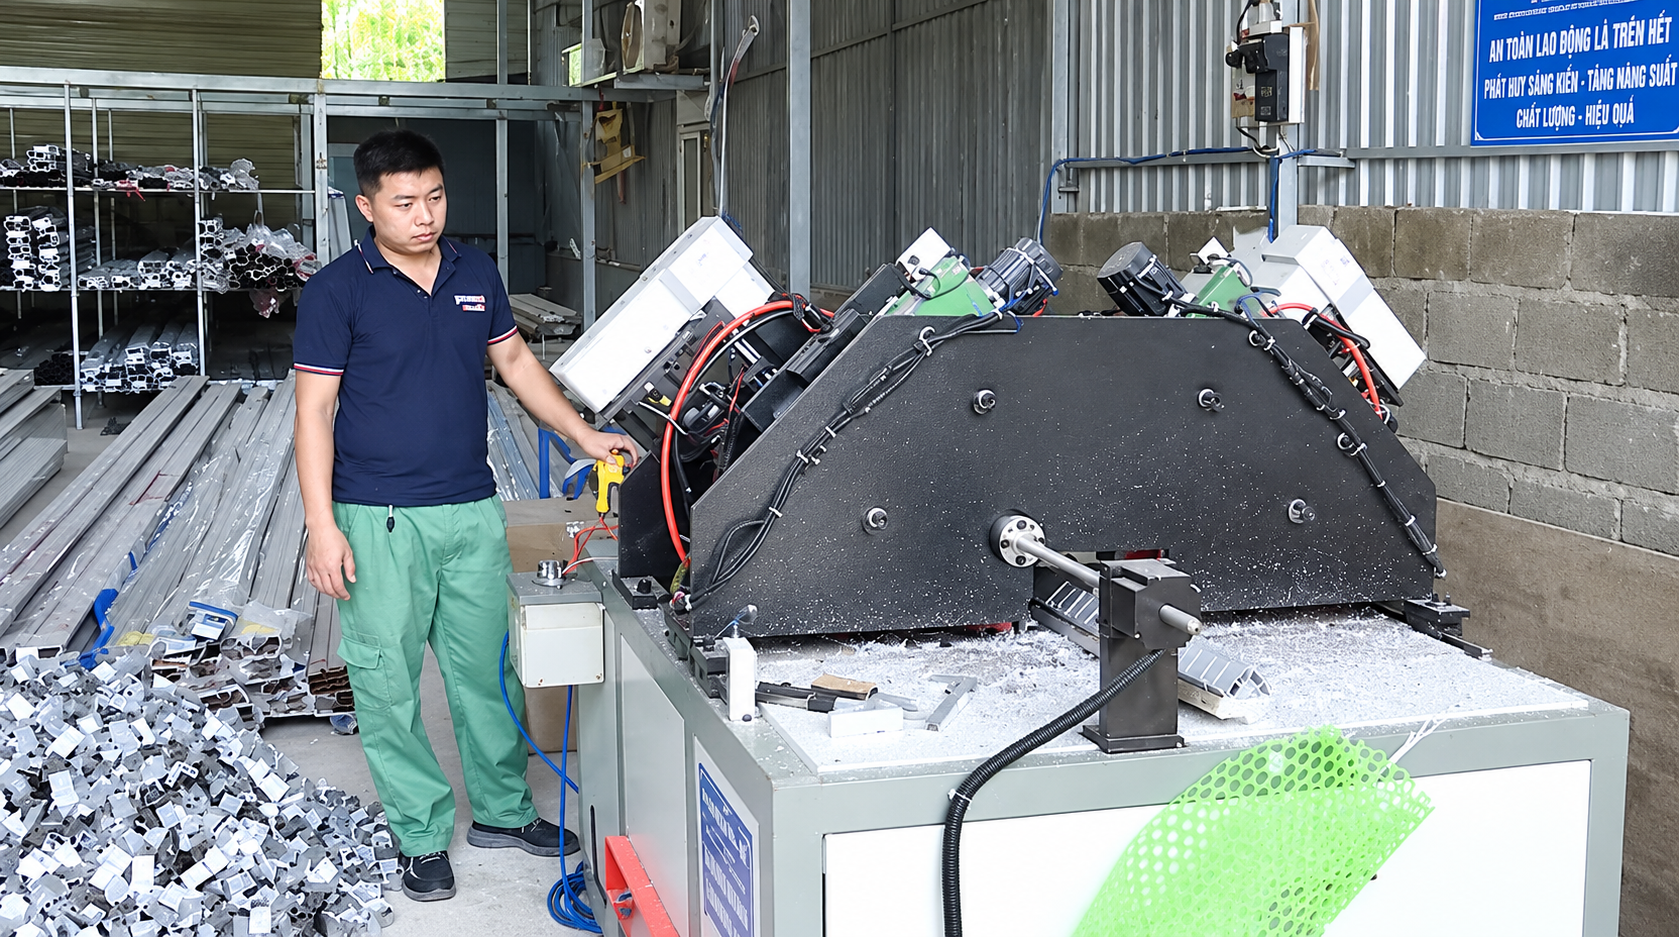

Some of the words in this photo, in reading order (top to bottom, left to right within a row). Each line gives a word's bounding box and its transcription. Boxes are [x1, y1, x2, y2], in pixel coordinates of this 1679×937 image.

[1489, 38, 1504, 63] AN
[1536, 31, 1557, 57] LAO
[1647, 9, 1672, 46] HẾT
[1508, 75, 1526, 98] HUY
[1556, 63, 1579, 94] KIẾN
[1543, 104, 1576, 131] LƯỢNG
